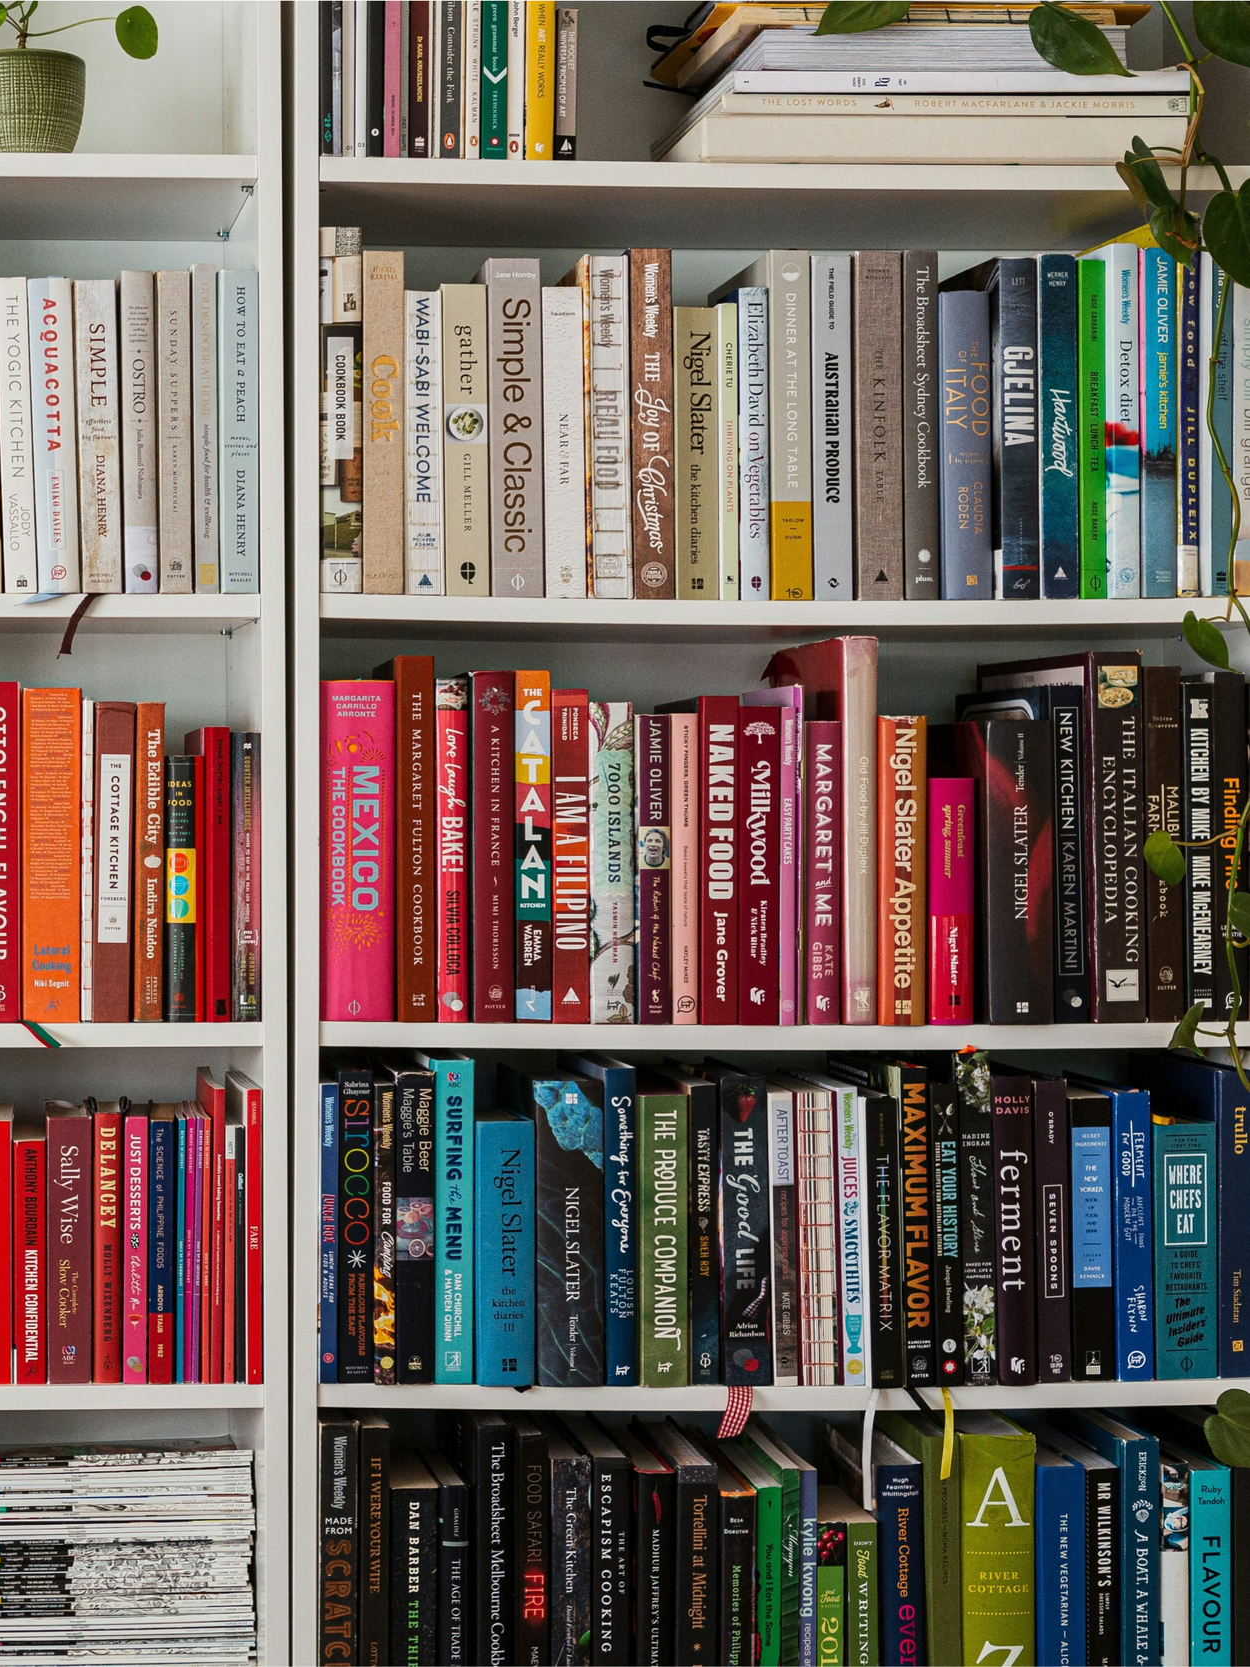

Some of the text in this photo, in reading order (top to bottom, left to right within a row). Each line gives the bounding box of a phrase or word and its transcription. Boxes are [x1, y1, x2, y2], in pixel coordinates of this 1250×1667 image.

[1157, 256, 1169, 343] JAMIE OLIVER
[42, 298, 61, 451] ACQUACOTTA
[90, 323, 107, 407] SIMPLE
[335, 355, 346, 441] COOKBOOK BOOK
[455, 325, 477, 394] gather
[503, 298, 532, 402] Simple
[1003, 346, 1035, 447] GJELINA
[1120, 339, 1133, 424] Detox diet
[416, 298, 431, 503] WABI-SABI WELCOME
[1159, 391, 1167, 429] kitchen
[96, 454, 107, 538] DIANA HENRY
[463, 453, 472, 532] GILL MELLER
[503, 441, 533, 554] Classic
[110, 776, 120, 889] COTTAGE KITCHEN
[331, 767, 345, 906] THE COOKBOOK
[351, 766, 379, 911] MEXICO
[442, 816, 463, 872] BAKE!
[609, 762, 621, 883] 7000 ISLANDS
[709, 726, 734, 900] NAKED FOOD
[889, 729, 917, 988] Nigel Slater Appetite
[1014, 804, 1028, 920] NIGEL SLATER
[1102, 756, 1116, 924] ENCYCLOPEDIA
[714, 911, 729, 1001] Jane Grover
[994, 1096, 1030, 1104] HOLLY
[995, 1106, 1029, 1115] DAVIS
[100, 1127, 116, 1228] DELANCEY
[494, 1148, 522, 1277] Nigel Slater
[999, 1150, 1028, 1291] ferment
[1169, 1166, 1202, 1185] WHERE
[1170, 1189, 1201, 1208] CHEFS
[1177, 1214, 1195, 1234] EAT
[654, 1110, 681, 1351] THE PRODUCE COMPANION
[409, 1502, 419, 1593] DAN BARBER
[524, 1575, 544, 1618] FIRE
[601, 1474, 611, 1653] ESCAPISM COOKING
[800, 1518, 817, 1617] kylie kwong
[969, 1585, 1029, 1593] COTTAGE
[979, 1572, 1019, 1580] RIVER
[1202, 1536, 1221, 1655] FLAVOUR
